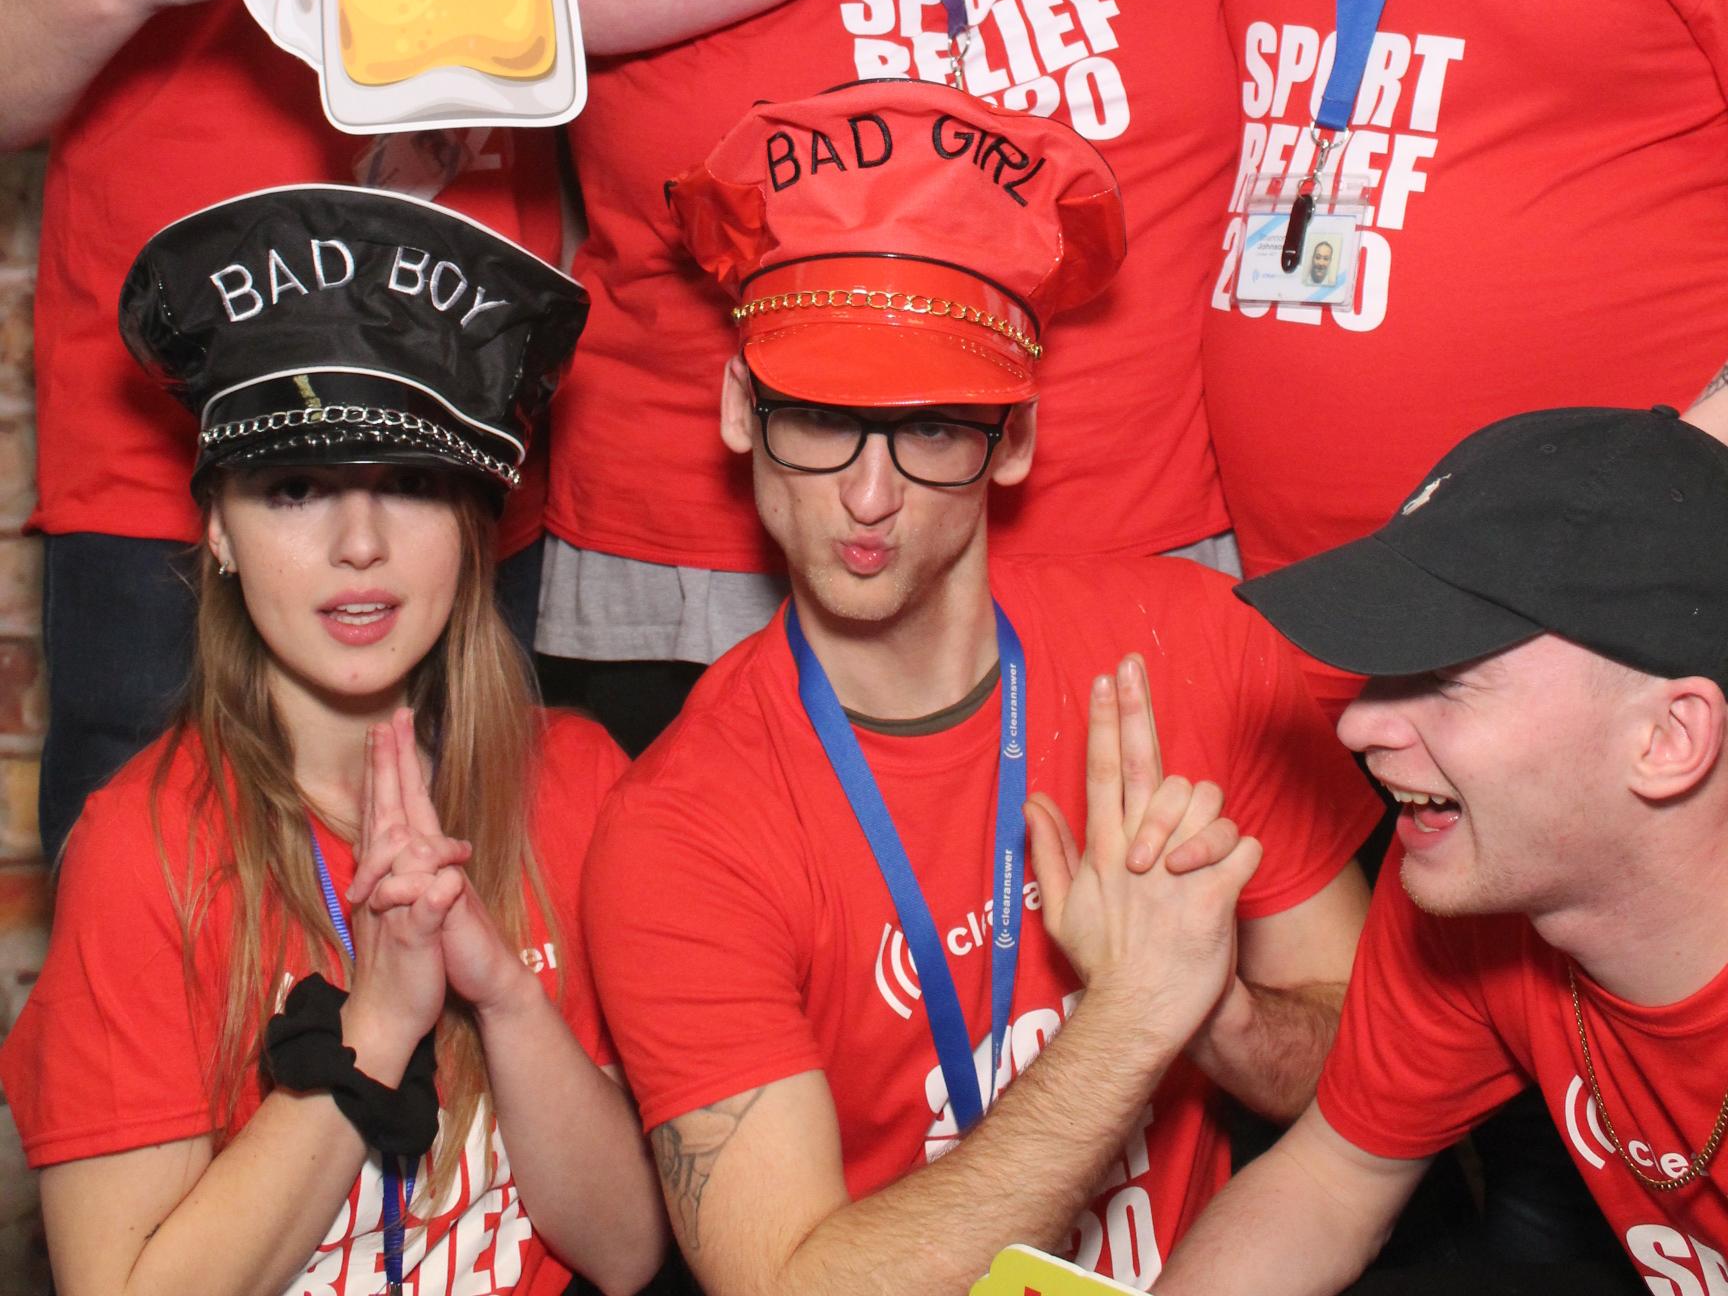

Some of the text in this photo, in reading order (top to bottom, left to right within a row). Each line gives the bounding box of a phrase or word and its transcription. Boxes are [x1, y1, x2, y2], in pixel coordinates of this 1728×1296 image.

[767, 113, 1047, 208] BAD GIRL
[211, 239, 507, 329] BAD BOY
[1010, 662, 1018, 737] clearanswer
[1003, 848, 1013, 926] clearanswer
